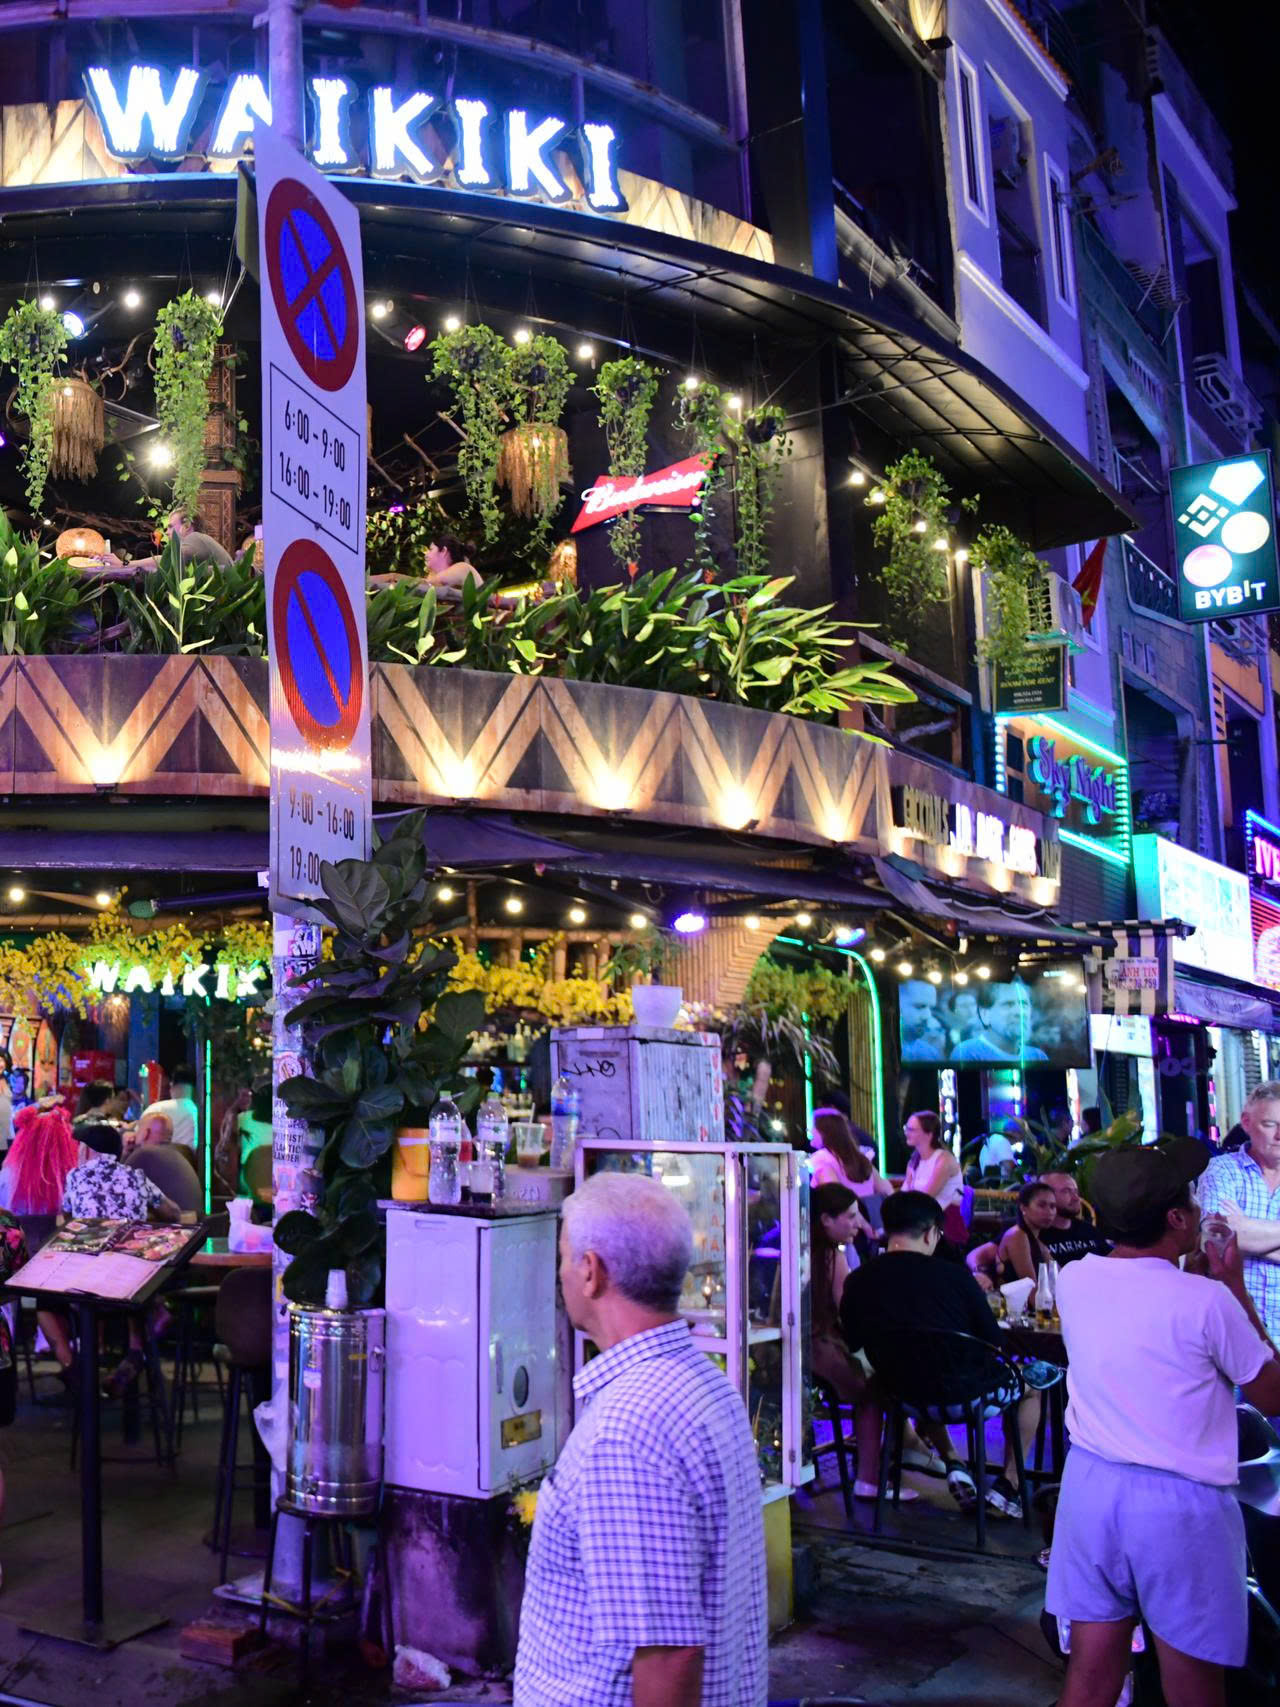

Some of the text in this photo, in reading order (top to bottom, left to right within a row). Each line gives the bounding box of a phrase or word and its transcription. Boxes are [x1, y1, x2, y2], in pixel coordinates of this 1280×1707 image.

[87, 64, 619, 208] WAIKIKI
[284, 399, 309, 445] 6:00
[322, 428, 345, 472] 9:00
[279, 451, 309, 500] 16:00
[322, 484, 351, 530] 19:00
[1194, 579, 1267, 610] BYBIT
[289, 784, 313, 825] 9:00
[327, 801, 355, 841] 16:00
[289, 845, 320, 886] 19:00
